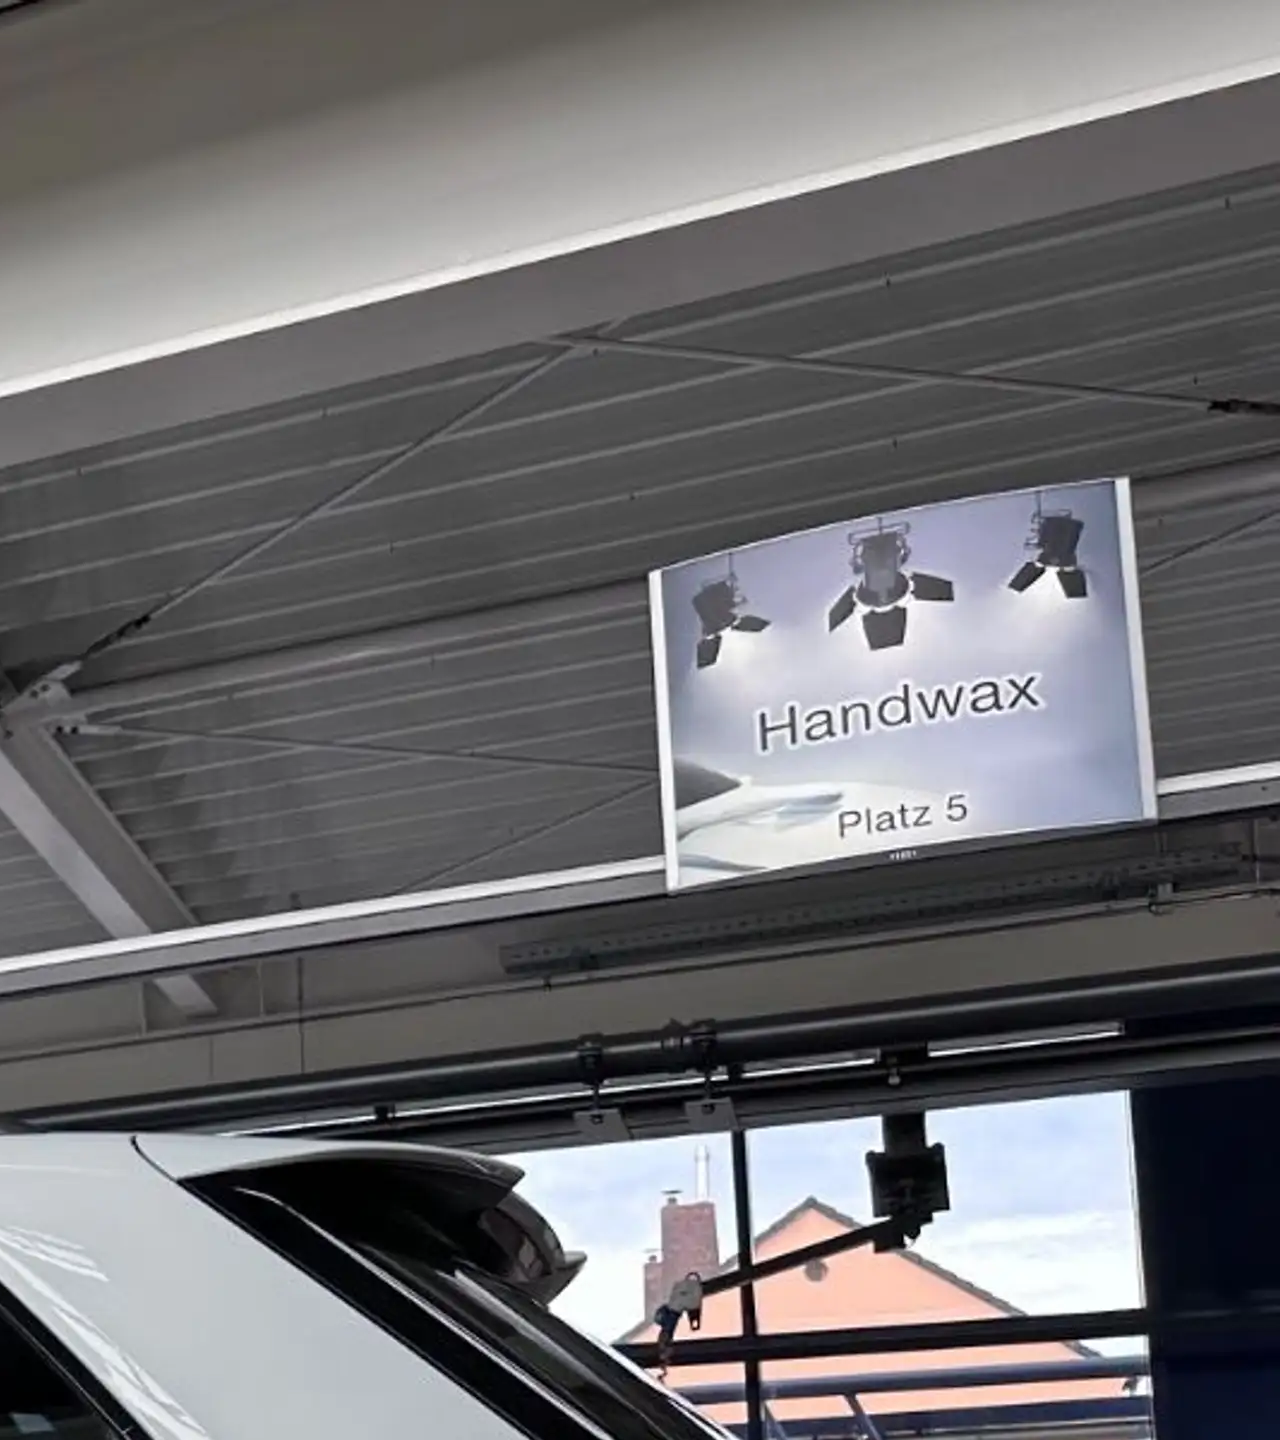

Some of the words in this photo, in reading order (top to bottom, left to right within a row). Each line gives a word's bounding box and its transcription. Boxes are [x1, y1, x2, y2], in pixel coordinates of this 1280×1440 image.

[758, 675, 1041, 752] Handwax
[838, 803, 933, 839] Platz
[945, 794, 969, 823] 5
